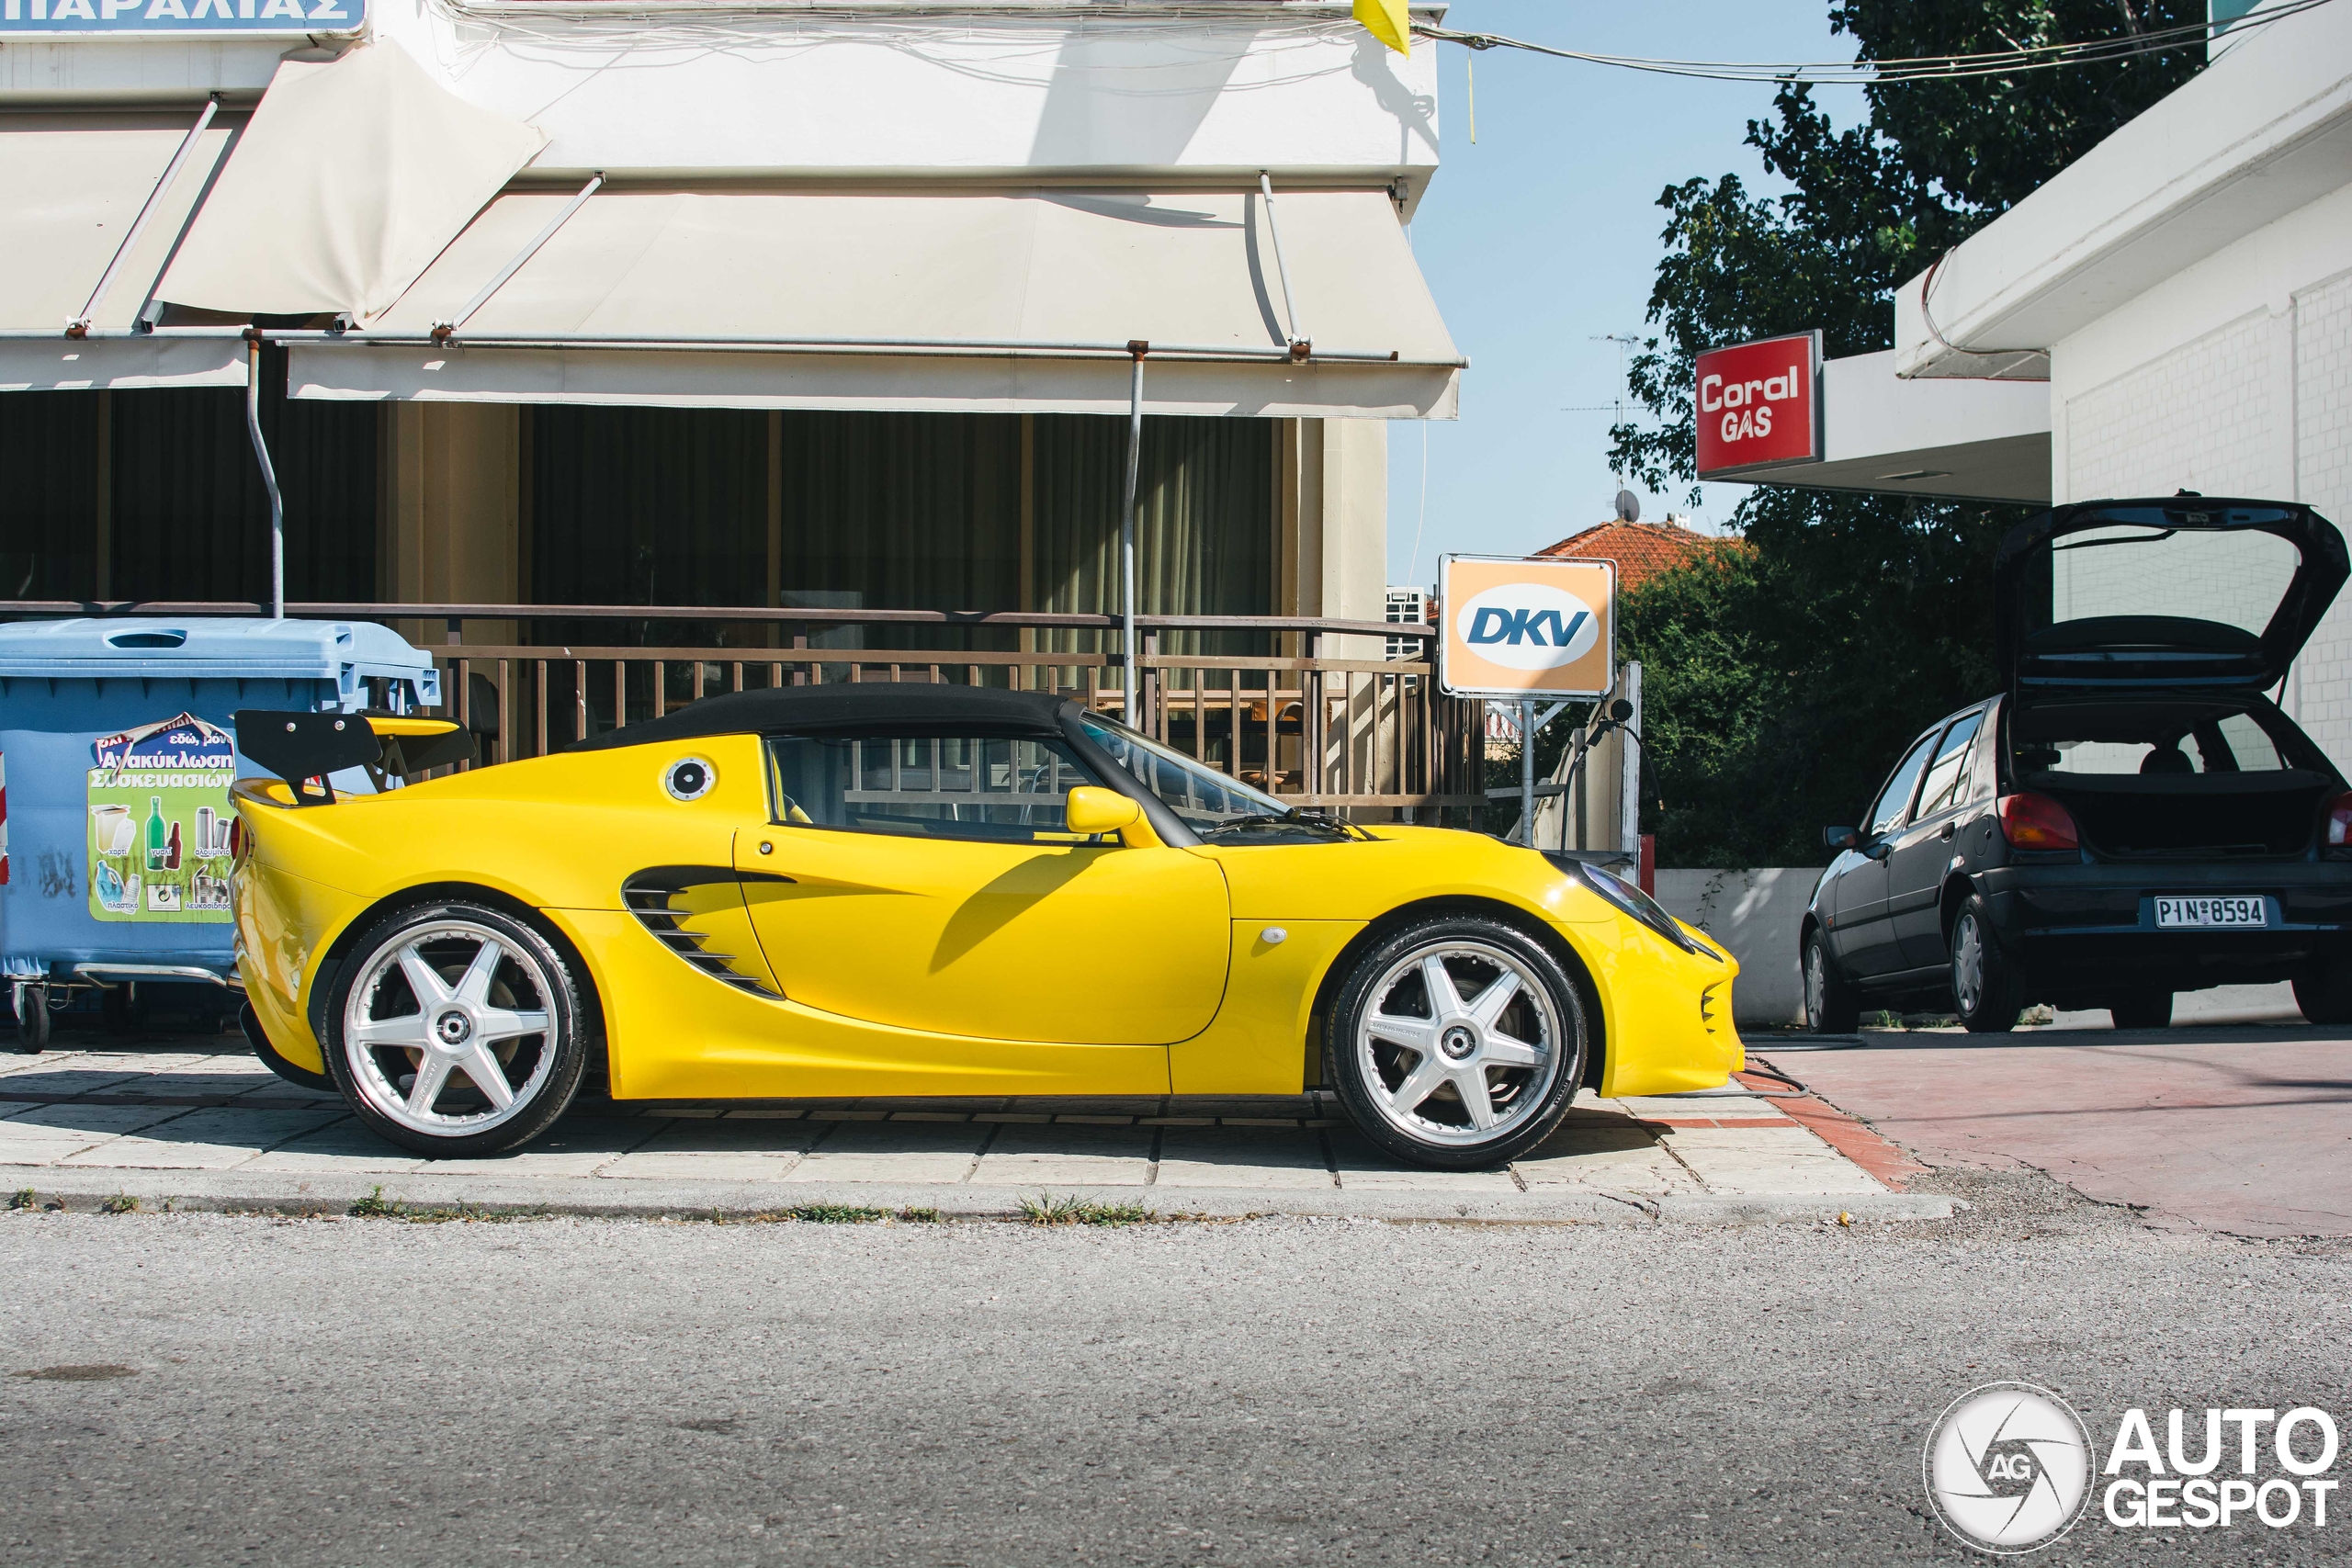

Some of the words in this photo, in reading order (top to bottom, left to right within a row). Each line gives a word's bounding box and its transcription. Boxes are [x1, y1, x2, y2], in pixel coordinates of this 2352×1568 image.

[5, 0, 348, 20] ΠΑΡΑΛΙΑΣ
[1702, 366, 1798, 412] Coral
[1721, 406, 1772, 443] GAS
[1467, 607, 1589, 647] DKV
[169, 733, 199, 746] εδώ,
[91, 769, 235, 788] Συσκευασιών
